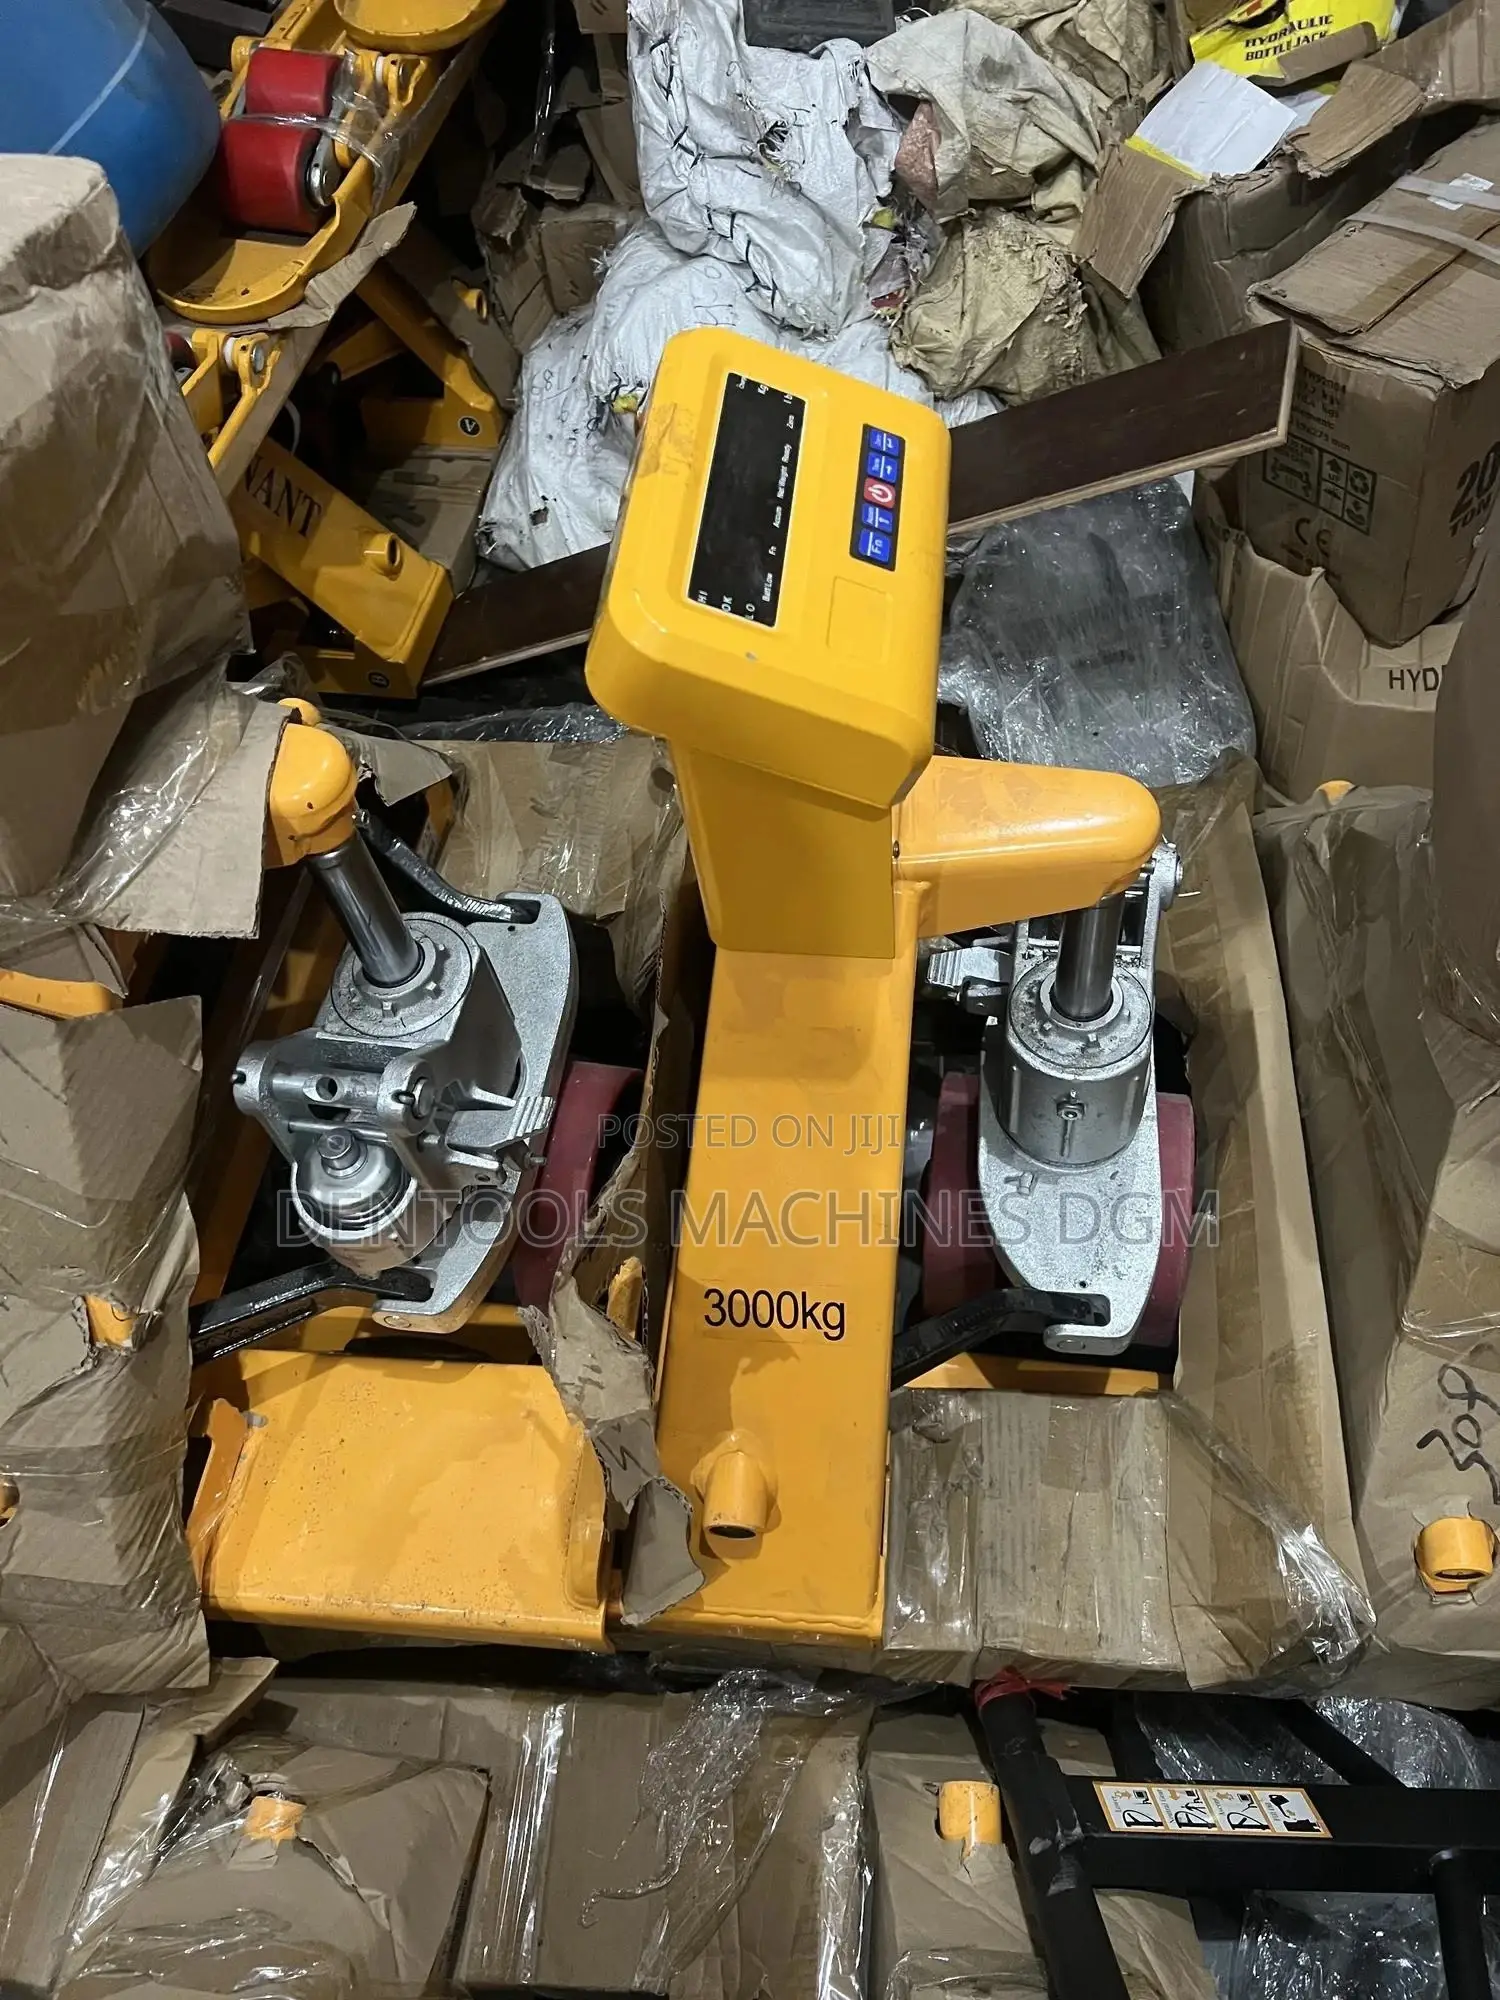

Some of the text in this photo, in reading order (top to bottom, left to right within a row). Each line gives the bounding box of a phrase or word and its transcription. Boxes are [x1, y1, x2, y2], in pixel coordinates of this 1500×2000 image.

[1245, 15, 1333, 47] HYDRAULIC
[1449, 440, 1500, 523] 20
[721, 595, 733, 612] OK
[703, 1288, 845, 1341] 3000kg
